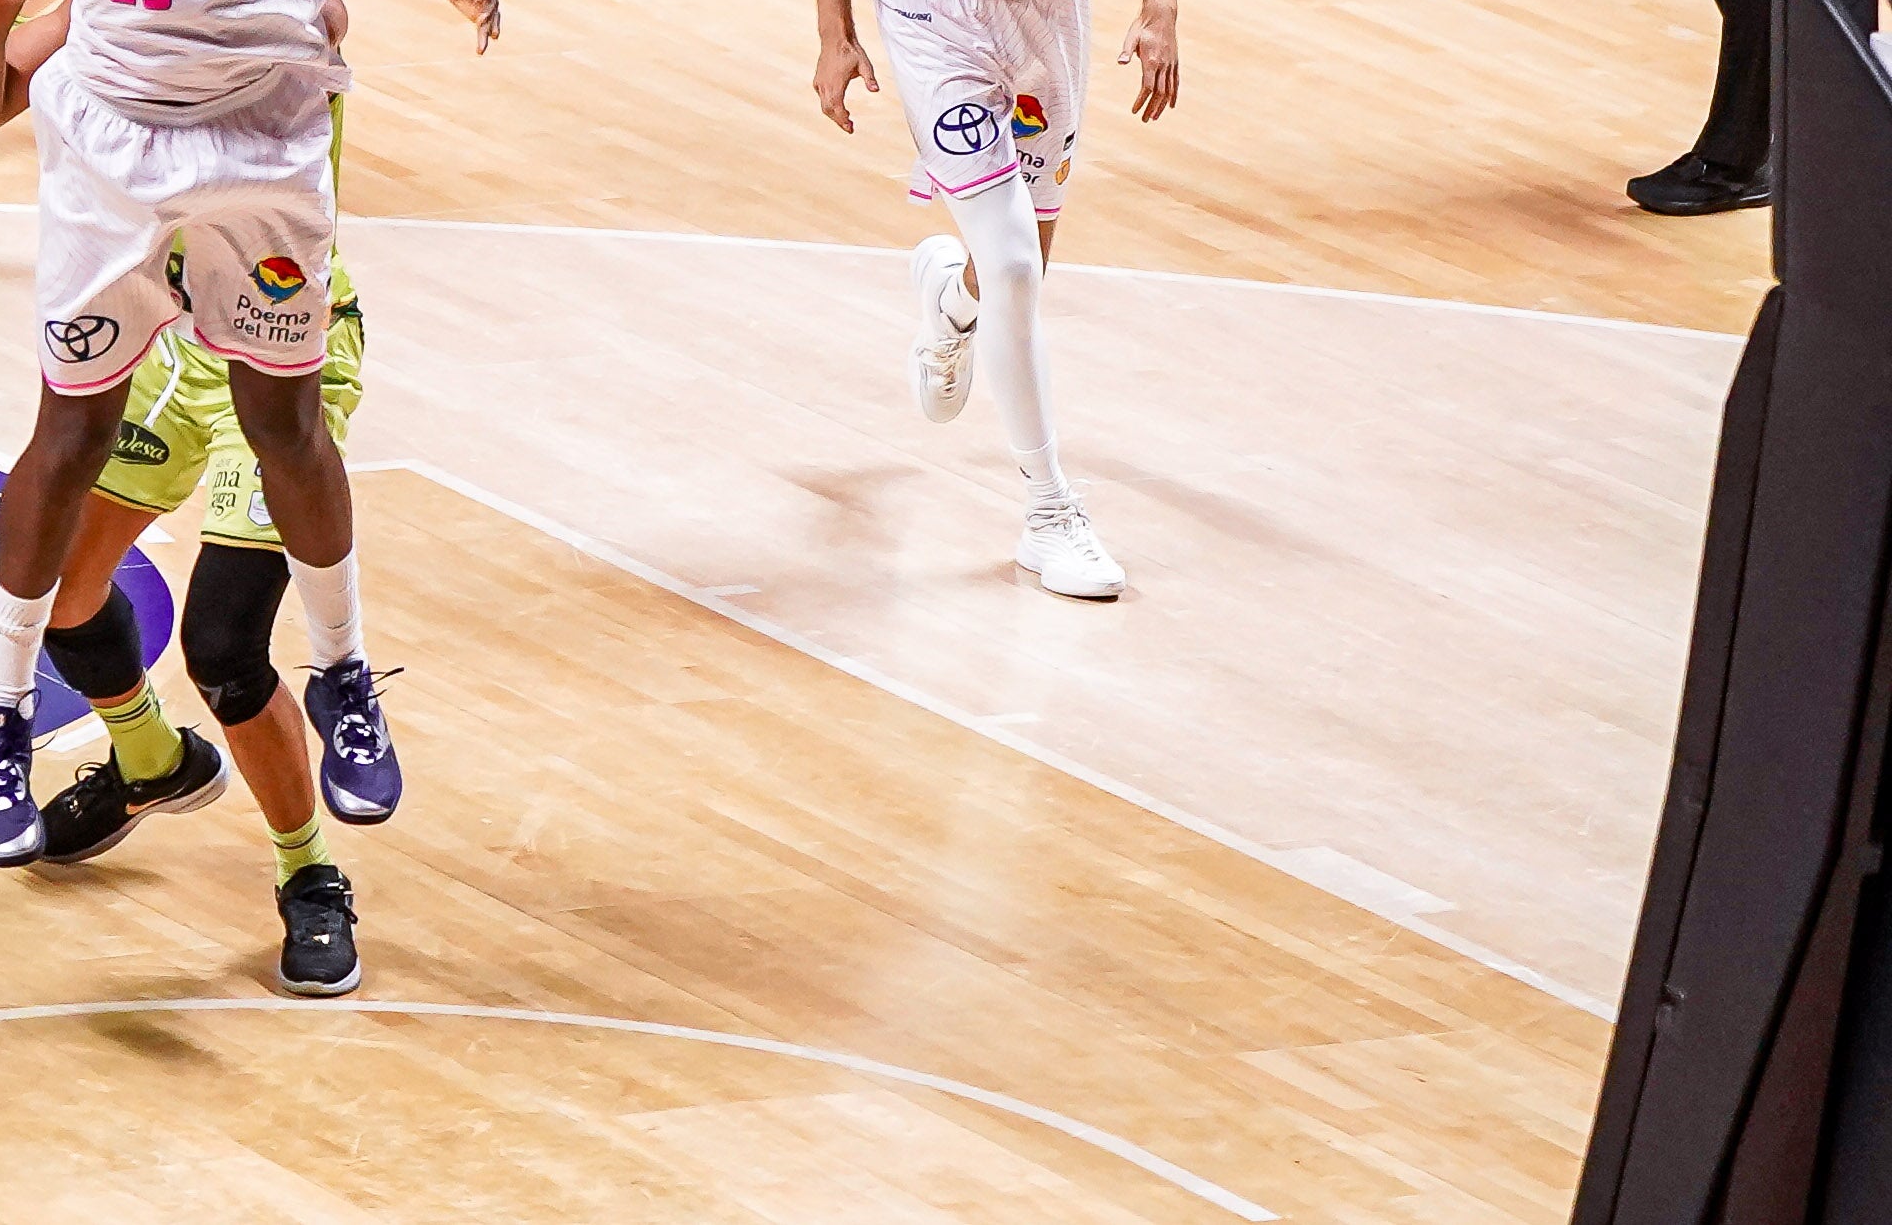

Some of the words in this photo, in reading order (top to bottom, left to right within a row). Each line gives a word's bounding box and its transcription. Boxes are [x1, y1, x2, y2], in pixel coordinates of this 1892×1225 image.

[236, 294, 311, 327] Poema
[233, 317, 261, 339] del
[268, 325, 309, 343] Mar
